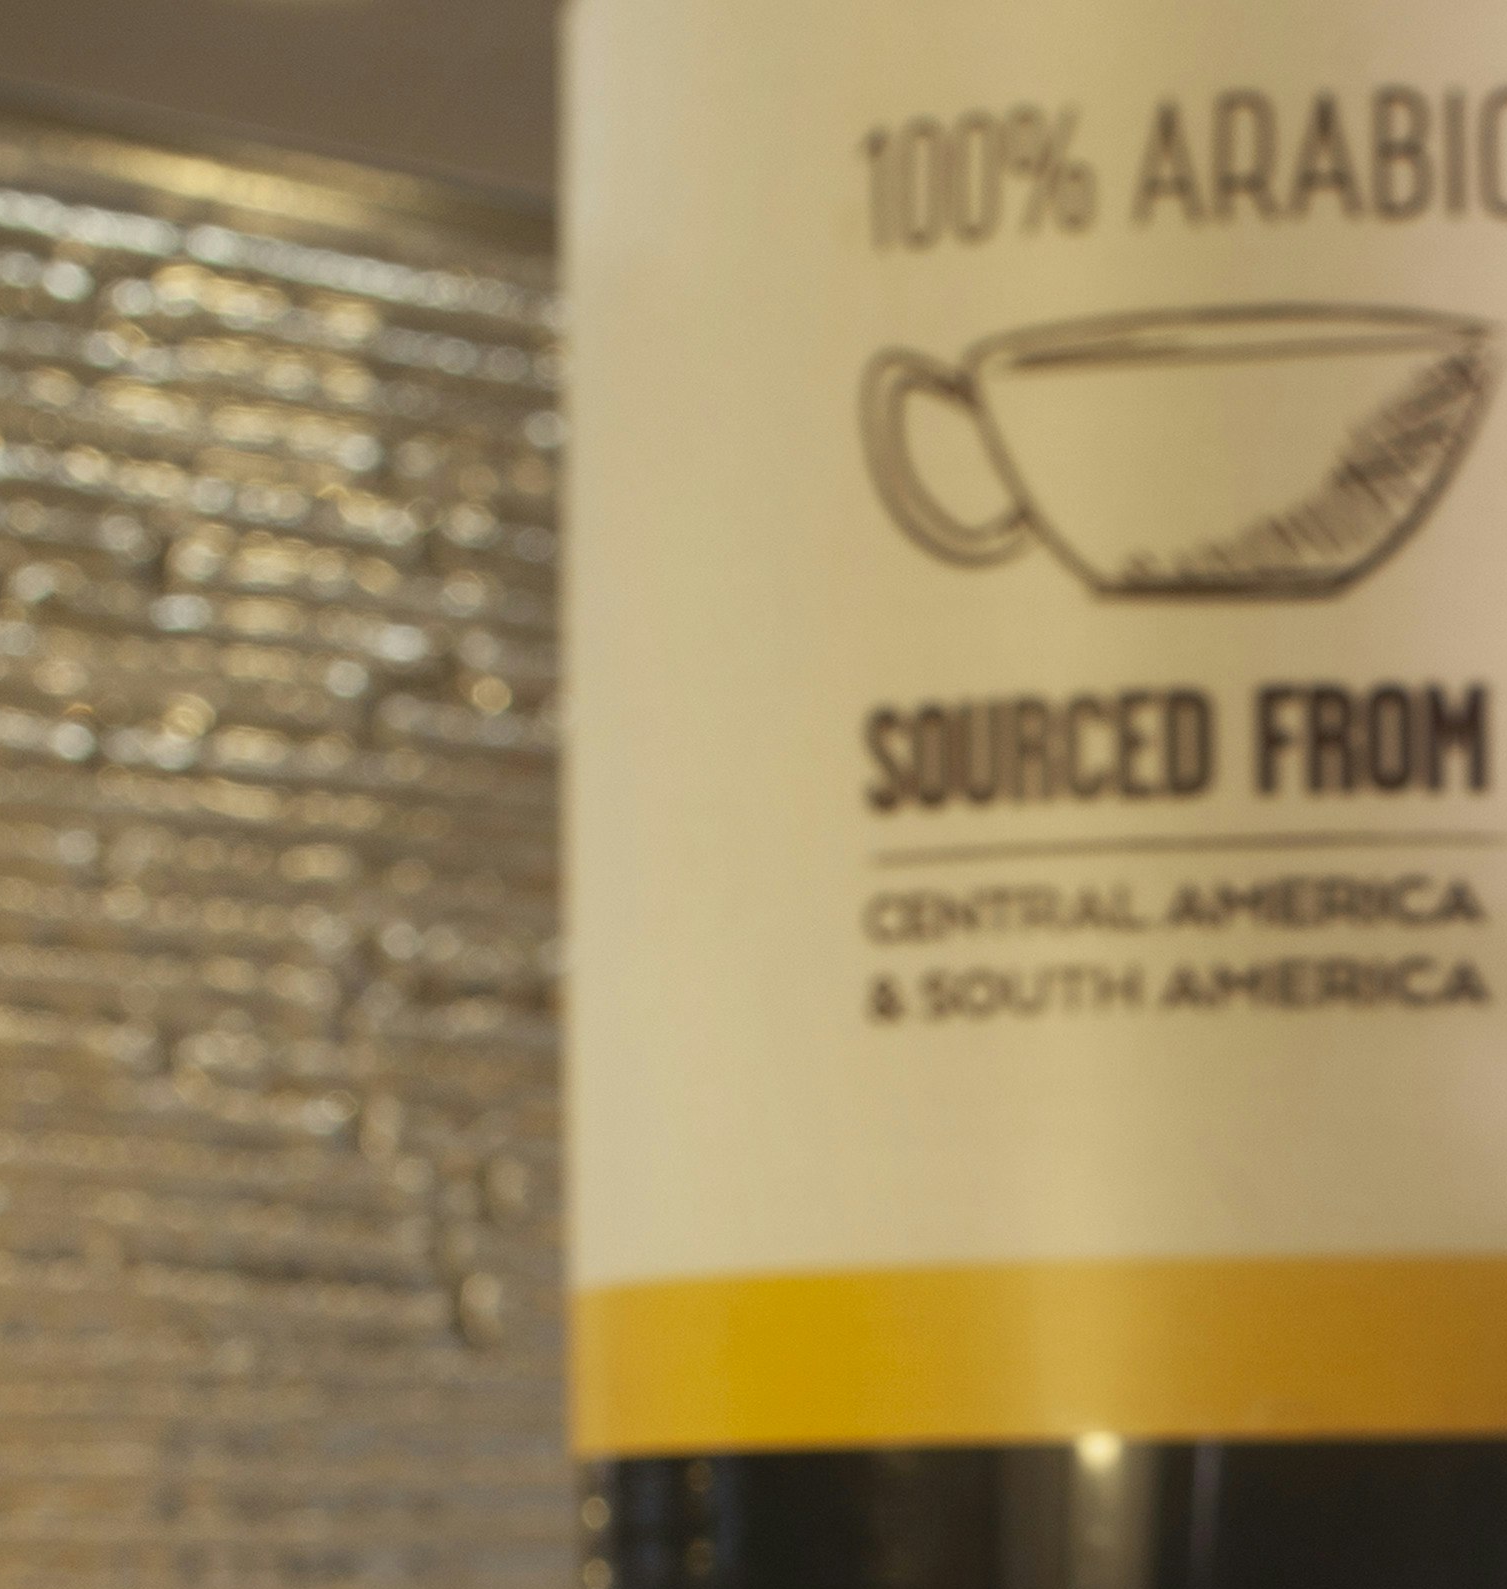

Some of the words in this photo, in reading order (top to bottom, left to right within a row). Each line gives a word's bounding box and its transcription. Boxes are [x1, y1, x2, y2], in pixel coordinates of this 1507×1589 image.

[862, 104, 1096, 252] 100%
[864, 684, 1219, 816] SOURCED
[1254, 680, 1491, 797] FROM
[860, 882, 1150, 948] CENTRAL
[1164, 873, 1487, 932] AMERICA
[865, 969, 904, 1026] &
[918, 961, 1146, 1024] SOUTH
[1158, 955, 1488, 1012] AMERICA
